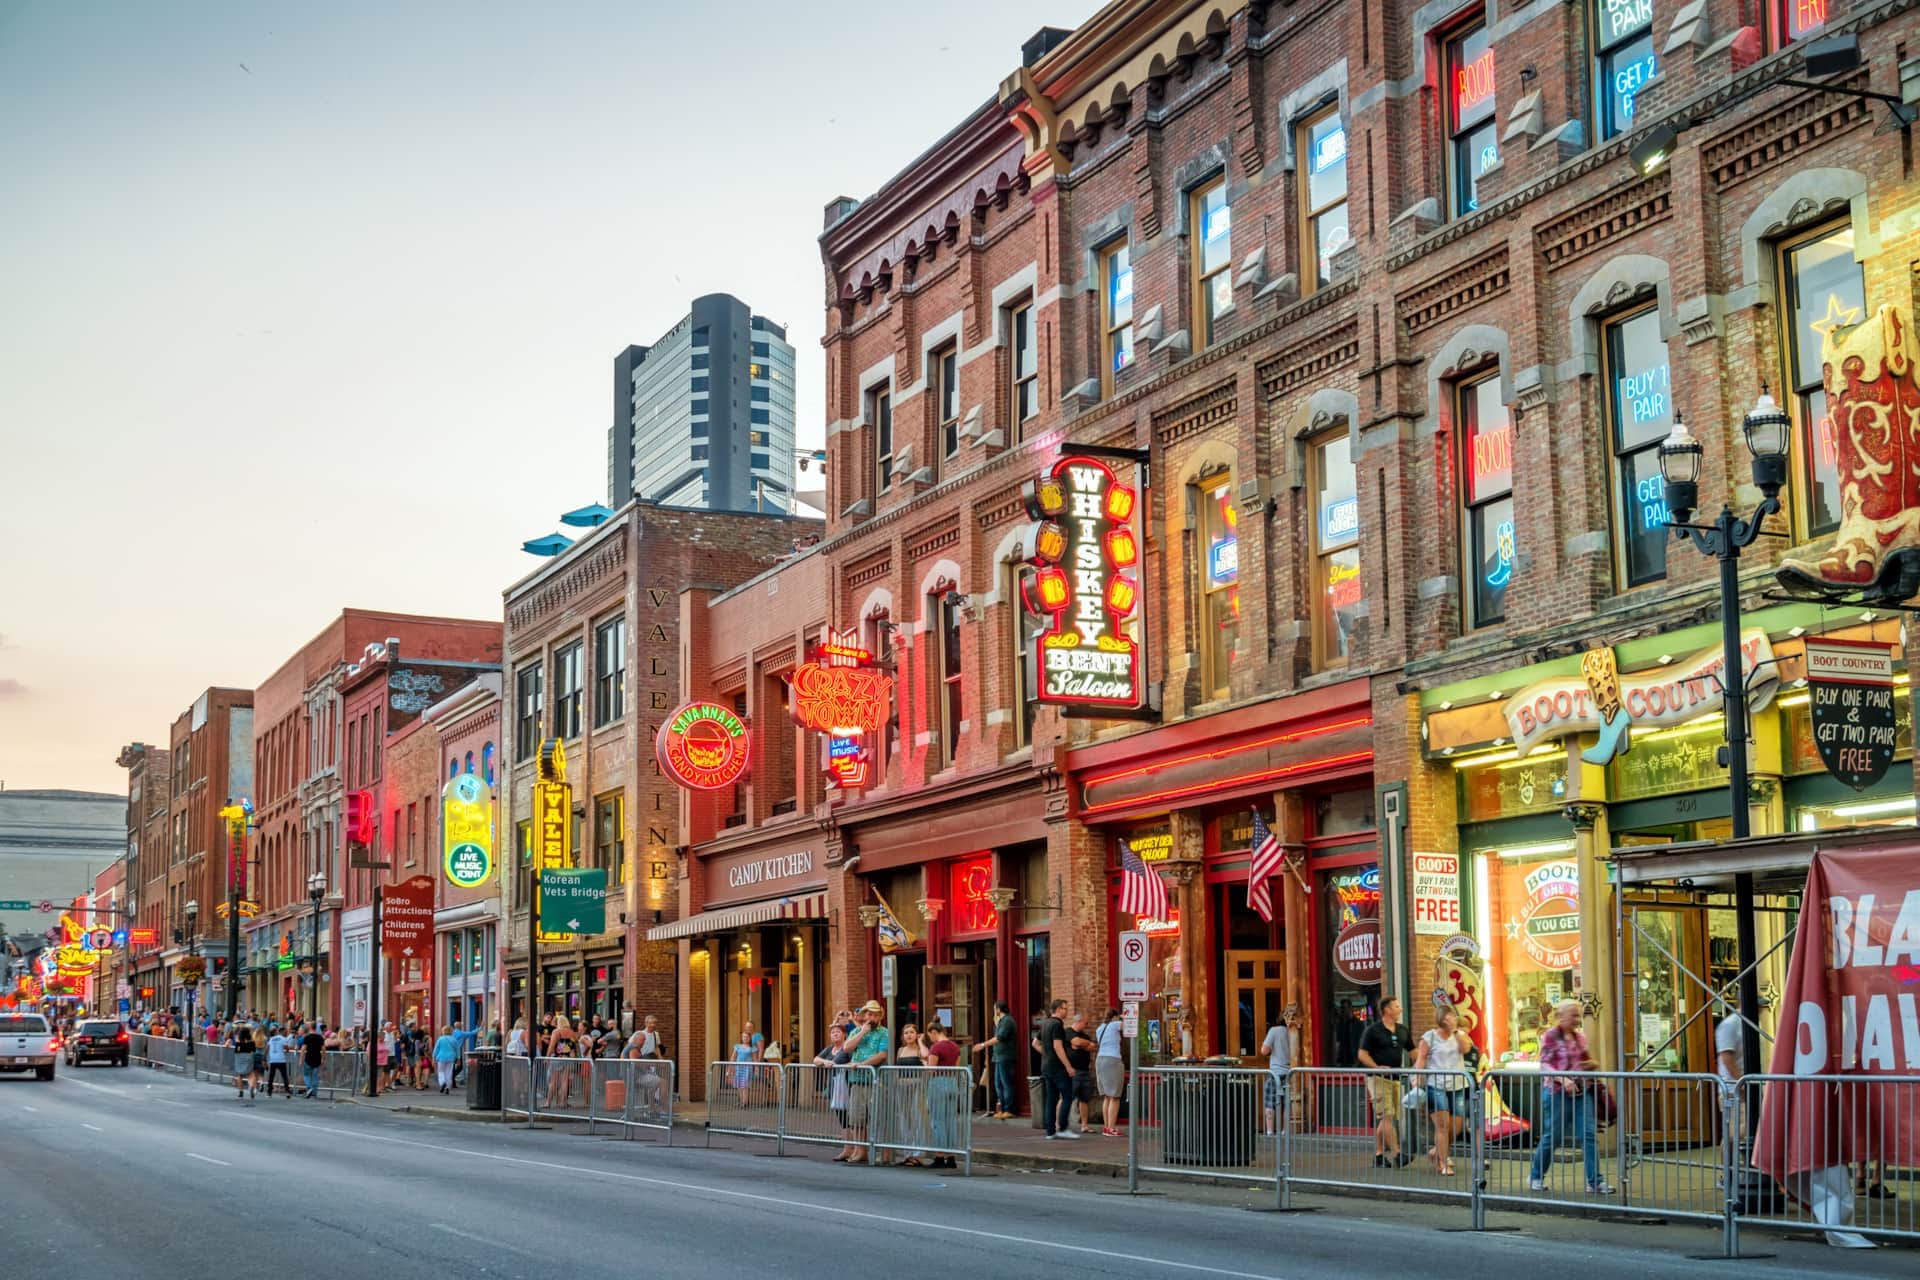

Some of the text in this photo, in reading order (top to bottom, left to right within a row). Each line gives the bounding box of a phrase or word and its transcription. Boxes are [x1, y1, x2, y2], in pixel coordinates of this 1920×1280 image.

[1615, 55, 1655, 94] GET 2
[1626, 365, 1667, 399] BUY 1
[1633, 394, 1665, 424] PAIR
[1637, 475, 1664, 503] GET
[1068, 466, 1105, 646] WHISKEY
[1047, 649, 1131, 675] BENT
[1813, 655, 1886, 671] BOOT COUNTRY
[793, 662, 894, 700] CRAZY
[1047, 670, 1132, 699] Saloon
[1515, 637, 1762, 737] BOOT COUNTY
[1815, 687, 1892, 710] BUY ONE PAIR
[671, 705, 745, 737] SAVANNAH'S
[797, 697, 882, 731] TOWN
[1847, 707, 1860, 723] &
[1817, 722, 1895, 746] GET TWO PAIR
[669, 746, 745, 785] CANDY KITCHEN
[1838, 747, 1873, 773] FREE
[454, 861, 483, 870] MUSIC
[459, 852, 478, 862] LIVE
[729, 850, 812, 888] CANDY KITCHEN
[1418, 857, 1456, 872] BOOTS
[456, 869, 481, 879] JOINT
[543, 874, 581, 886] Korean
[1418, 875, 1433, 885] BUY
[1439, 877, 1455, 886] PAIR
[1526, 864, 1580, 892] BOOT
[385, 897, 411, 905] SoBro
[544, 886, 605, 900] Vets Bridge
[1415, 885, 1458, 897] GET TWO PAIR
[385, 906, 433, 916] Attractions
[1415, 897, 1459, 922] FREE
[384, 920, 425, 930] Childrens
[385, 929, 418, 938] Theatre
[1535, 915, 1580, 932] YOU GET
[1338, 933, 1375, 961] WHISKEY
[1546, 953, 1571, 967] PAIR
